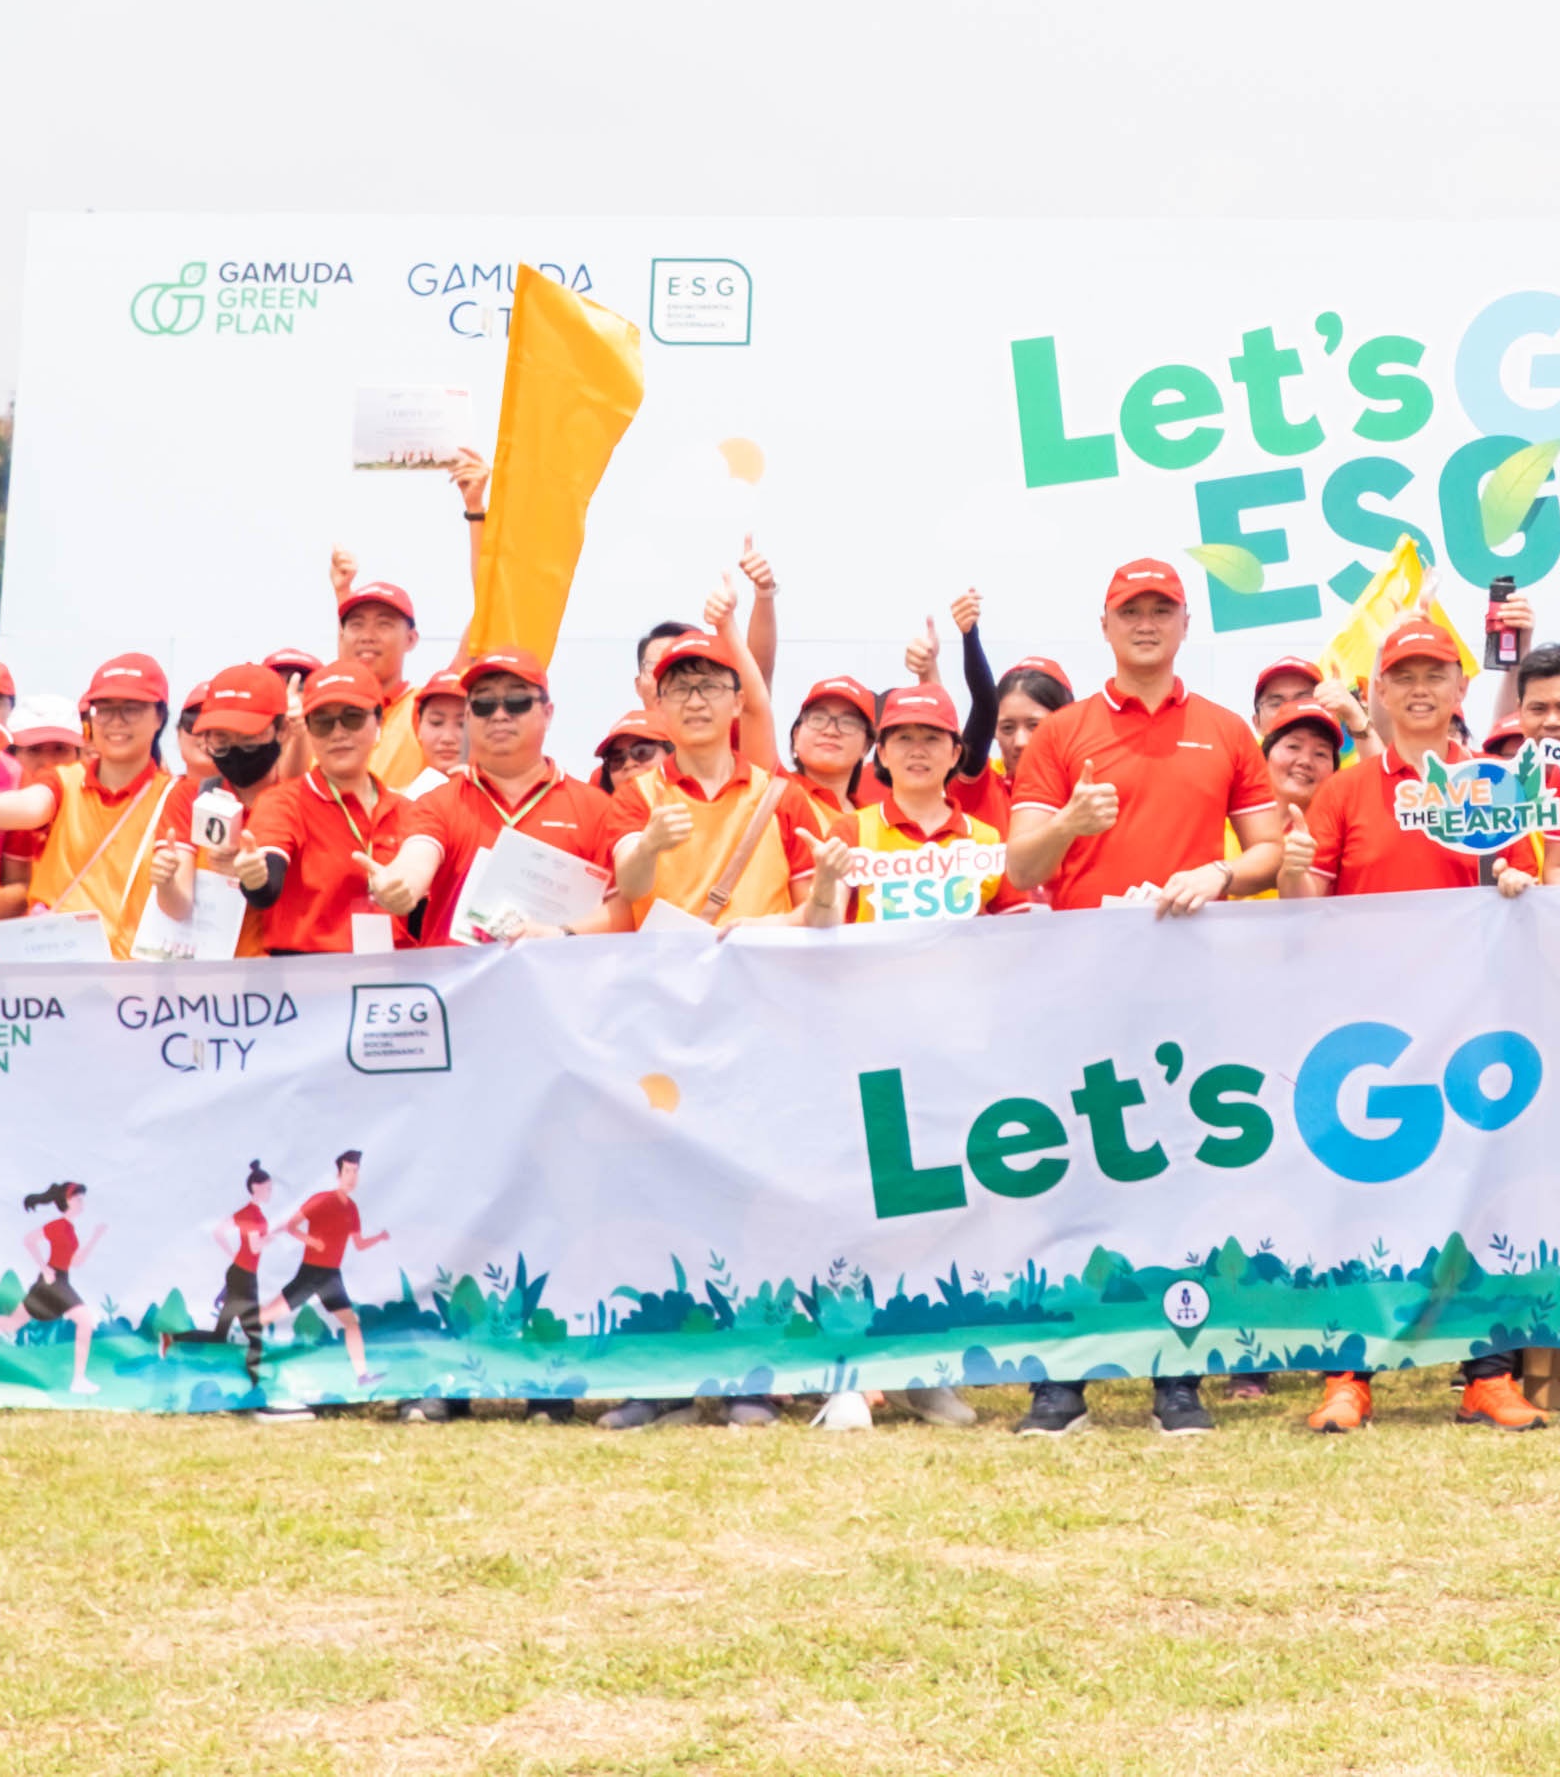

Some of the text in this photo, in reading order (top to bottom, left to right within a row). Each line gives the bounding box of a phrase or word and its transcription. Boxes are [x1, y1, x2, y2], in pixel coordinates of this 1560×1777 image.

[218, 261, 354, 284] GAMUDA
[216, 287, 319, 310] GREEN
[215, 313, 295, 336] PLAN
[449, 301, 513, 339] CIT
[1010, 310, 1435, 489] Let's
[1399, 778, 1493, 809] SAVE
[1400, 802, 1559, 835] THE EARTH
[881, 875, 974, 921] ESG
[116, 992, 298, 1030] GAMUDA
[160, 1032, 256, 1074] CITY
[858, 1040, 1276, 1220] Let's
[1292, 1021, 1543, 1184] Go
